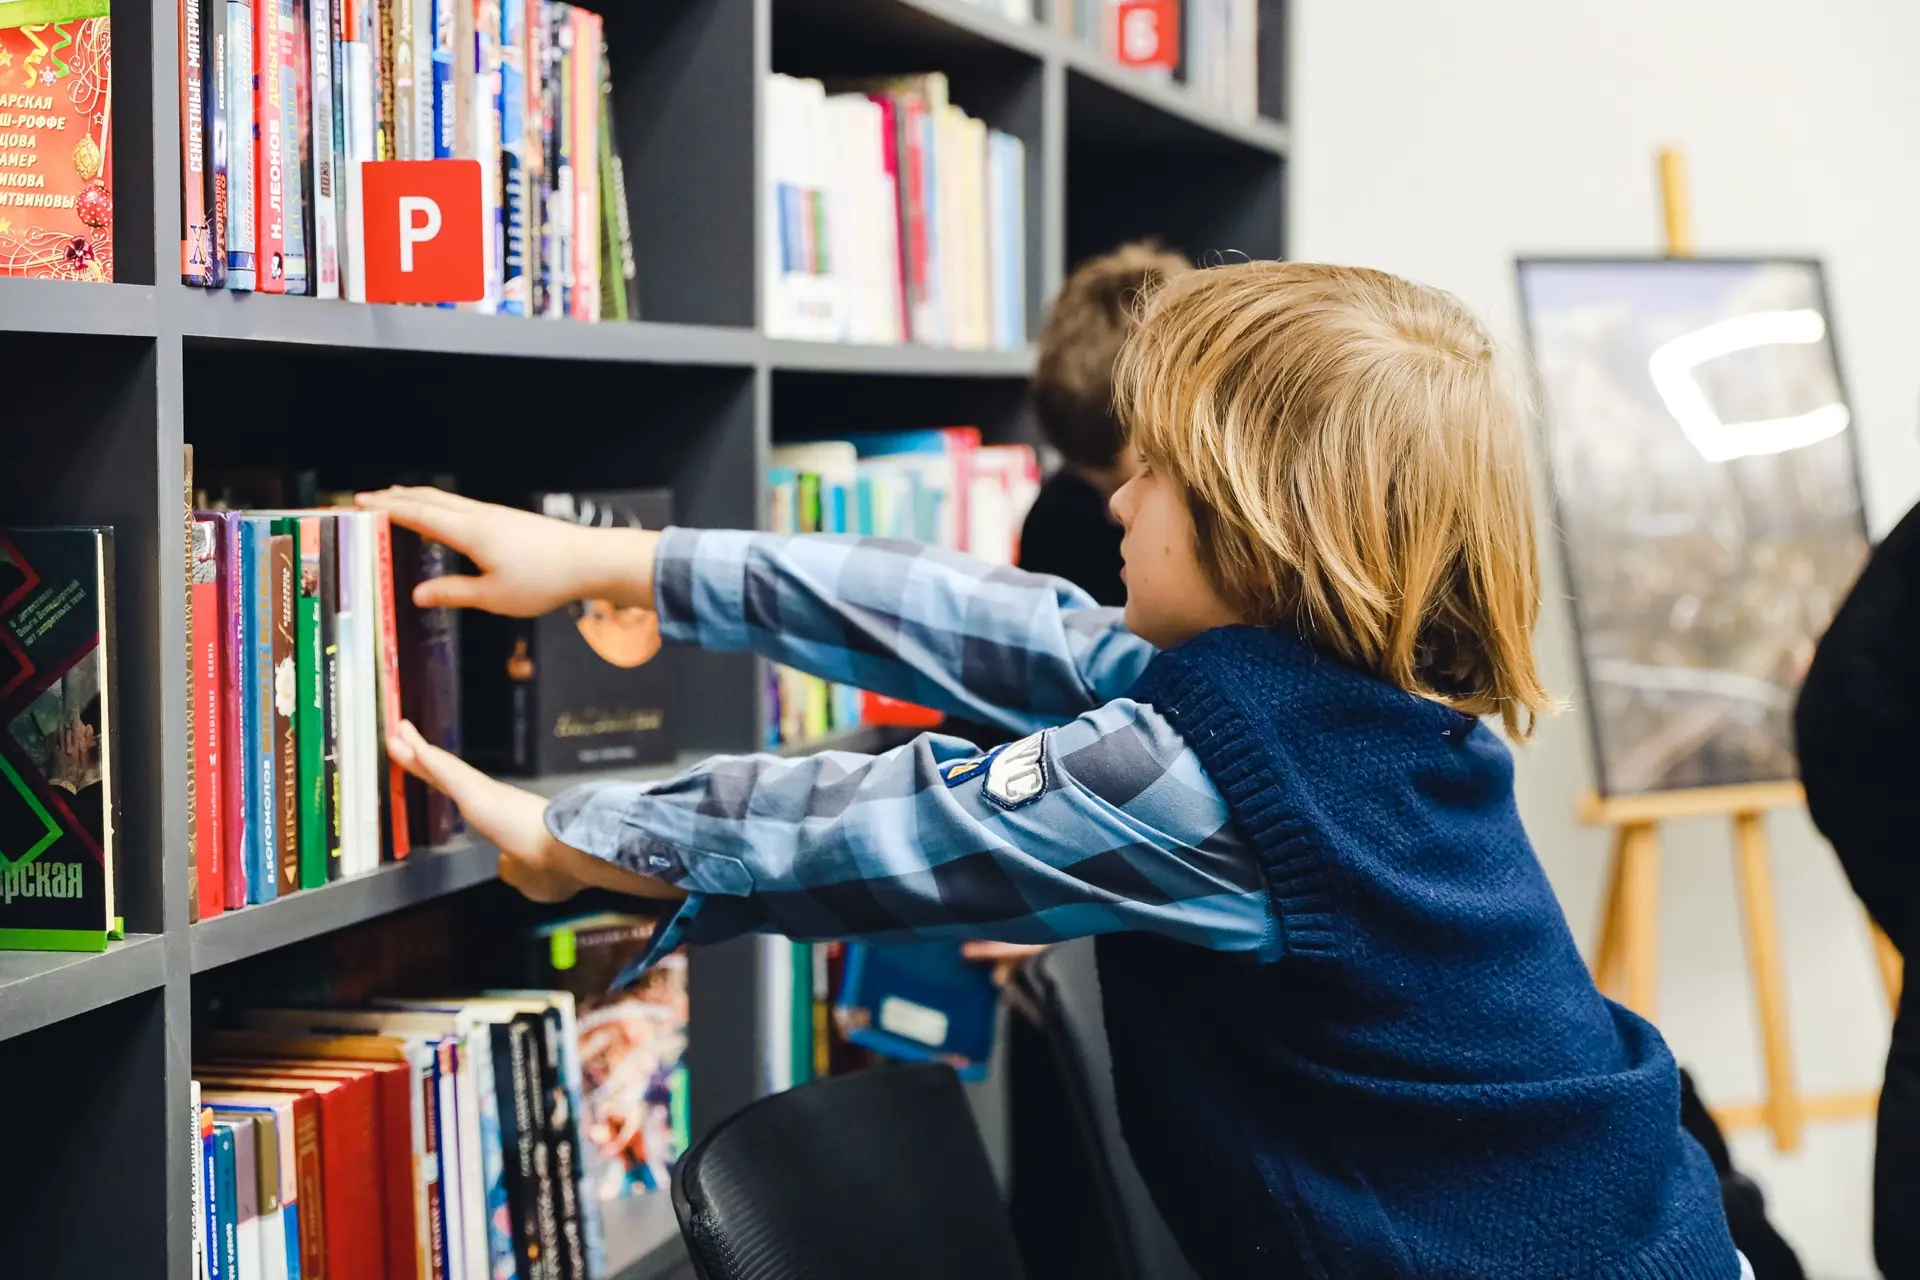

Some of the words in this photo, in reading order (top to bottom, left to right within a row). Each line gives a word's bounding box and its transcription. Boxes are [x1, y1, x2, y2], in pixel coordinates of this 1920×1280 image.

[268, 34, 279, 108] ДЕНЬГИ
[0, 93, 53, 111] АРСКАЯ
[0, 113, 66, 131] Ш-РОФФЕ
[188, 78, 202, 172] СЕКРЕТНЫЕ
[0, 152, 37, 168] АМЕР
[270, 119, 281, 212] ЛЕОНОВ
[0, 191, 76, 209] ИТВИНОВЫ
[215, 173, 226, 260] УГОЛОВНОЕ
[219, 173, 228, 217] ДЕЛО
[398, 196, 442, 272] Р
[284, 725, 296, 850] БЕРСЕНЕВА
[0, 862, 83, 904] рская
